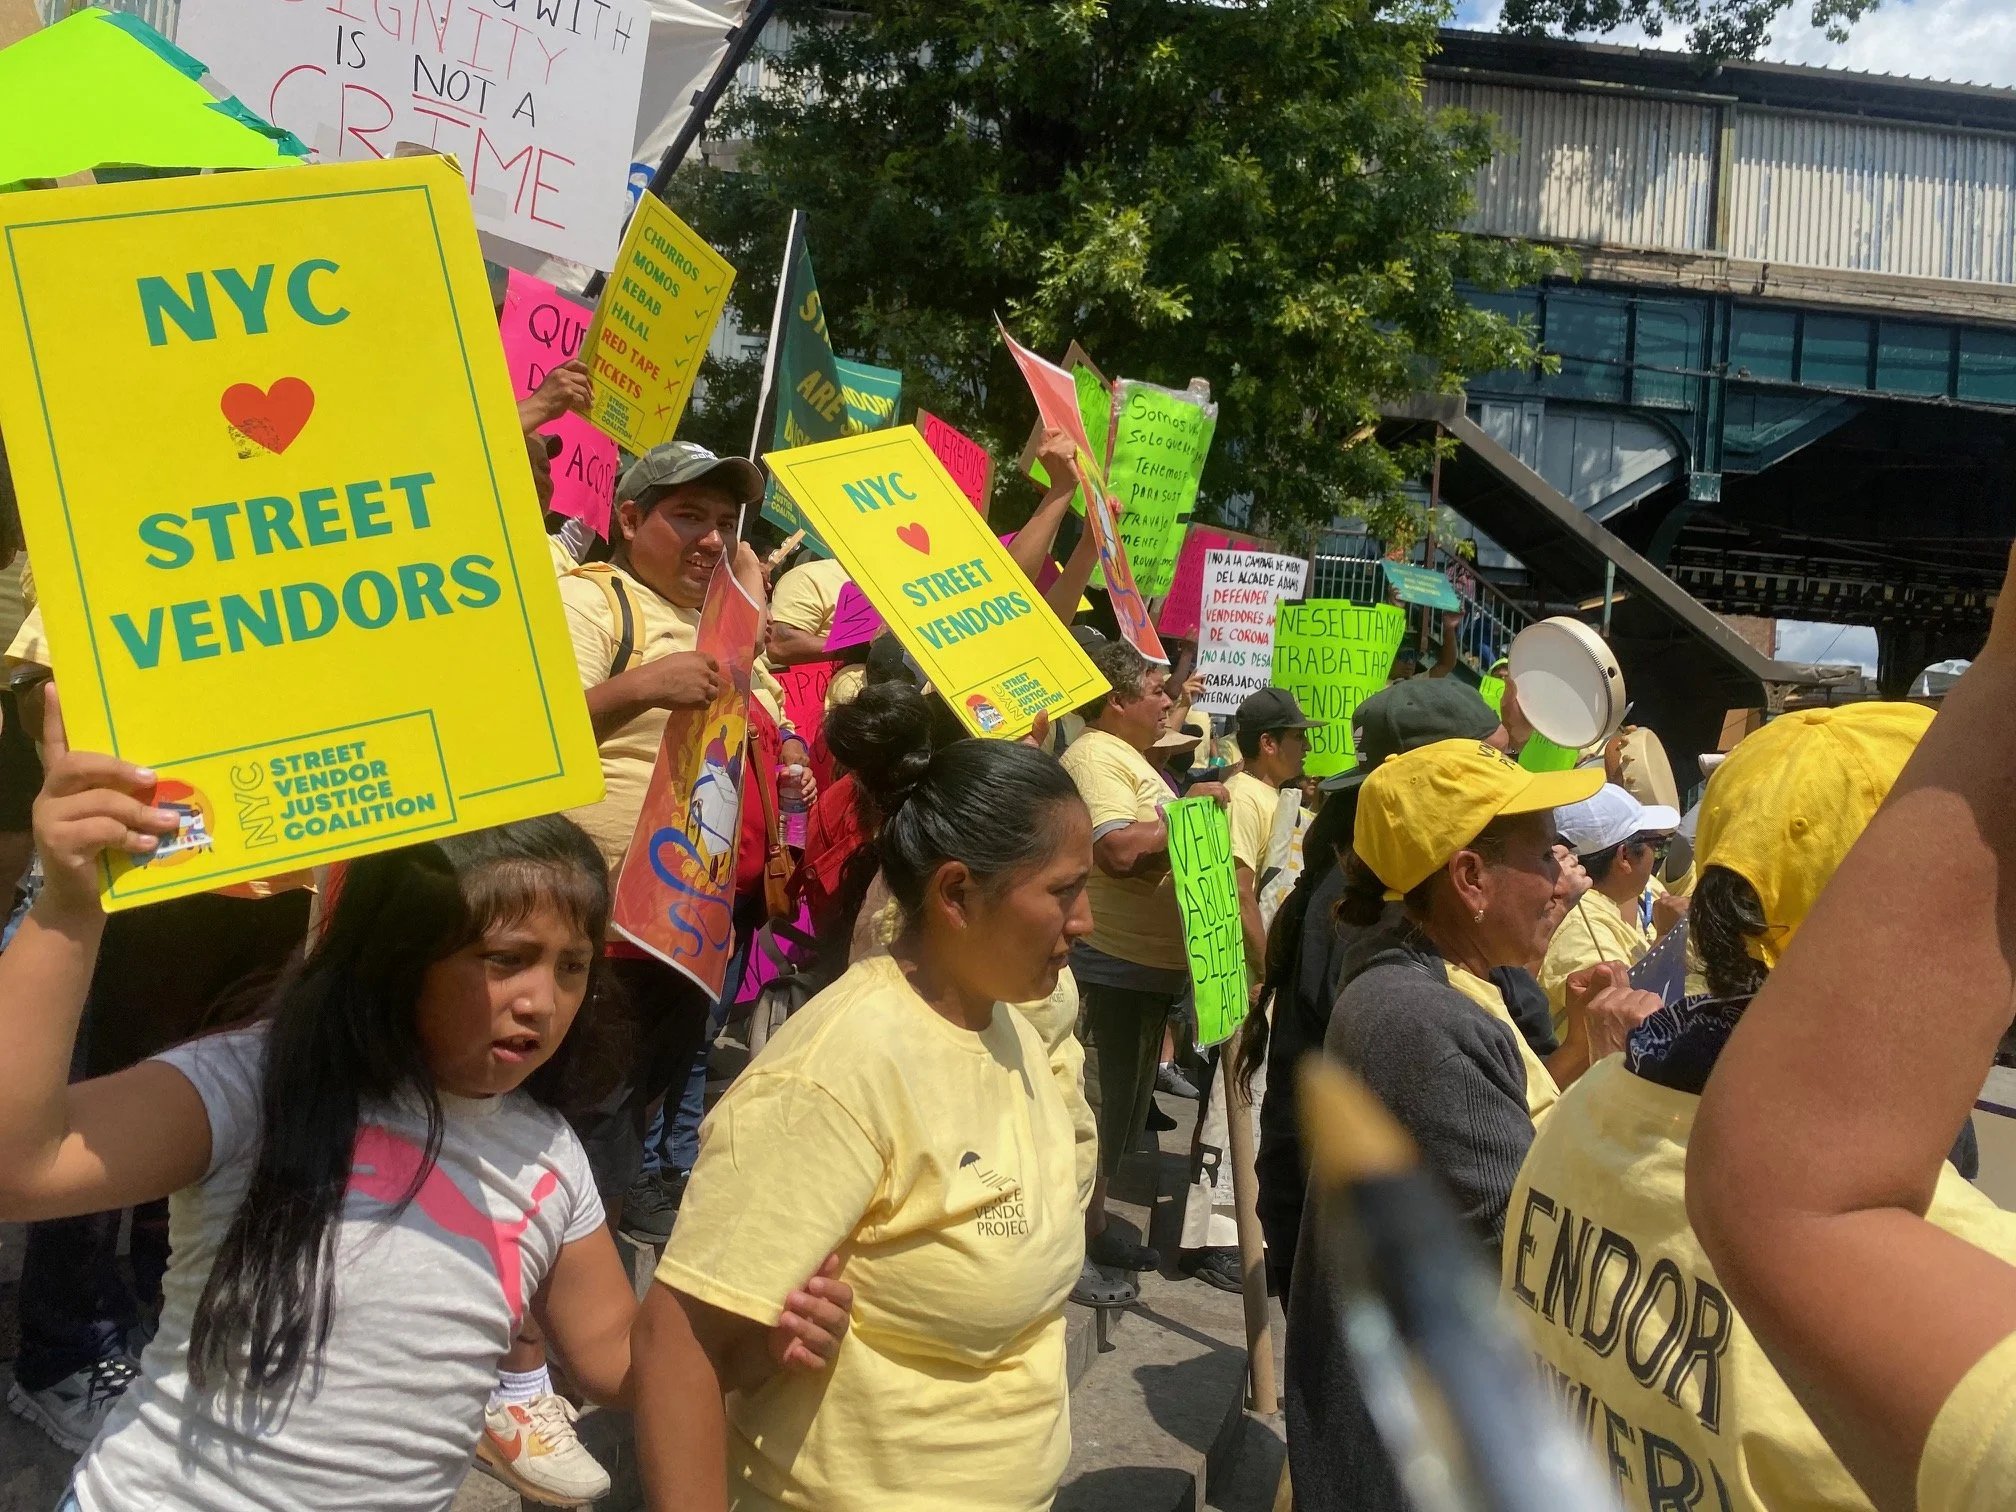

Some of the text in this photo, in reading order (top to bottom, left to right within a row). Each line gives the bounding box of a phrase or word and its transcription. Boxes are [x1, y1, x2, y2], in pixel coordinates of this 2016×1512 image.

[334, 25, 536, 128] IS NOT A
[270, 65, 576, 230] CRIME
[632, 250, 681, 298] MOMOS
[643, 226, 700, 282] CHURROS
[136, 258, 350, 347] NYC
[622, 276, 662, 317] KEBAB
[611, 301, 650, 342] HALAL
[601, 327, 661, 382] RED TAPE
[592, 353, 643, 400] TICKETS
[841, 472, 918, 514] NYC
[137, 471, 436, 570] STREET
[1216, 571, 1300, 593] DEL ALCALDE ADAMS
[1225, 552, 1231, 566] A
[1233, 553, 1243, 567] LA
[1276, 560, 1284, 572] DE
[902, 558, 993, 608] STREET
[109, 554, 502, 670] VENDORS
[916, 591, 1032, 650] VENDORS
[1206, 608, 1264, 625] VENDEDORES
[1210, 627, 1270, 645] DE CORONA
[1220, 649, 1228, 663] A
[1228, 650, 1246, 667] LOS
[1273, 645, 1388, 680] TRABAJAR
[1001, 671, 1030, 690] STREET
[1007, 679, 1042, 699] VENDOR
[1017, 687, 1049, 708] JUSTICE
[1022, 690, 1065, 716] COALITION
[269, 740, 367, 777] STREET
[273, 759, 388, 799] VENDOR
[229, 761, 279, 850] NYC
[280, 780, 393, 821] JUSTICE
[284, 792, 436, 842] COALITION
[1511, 1186, 1733, 1435] ENDOR
